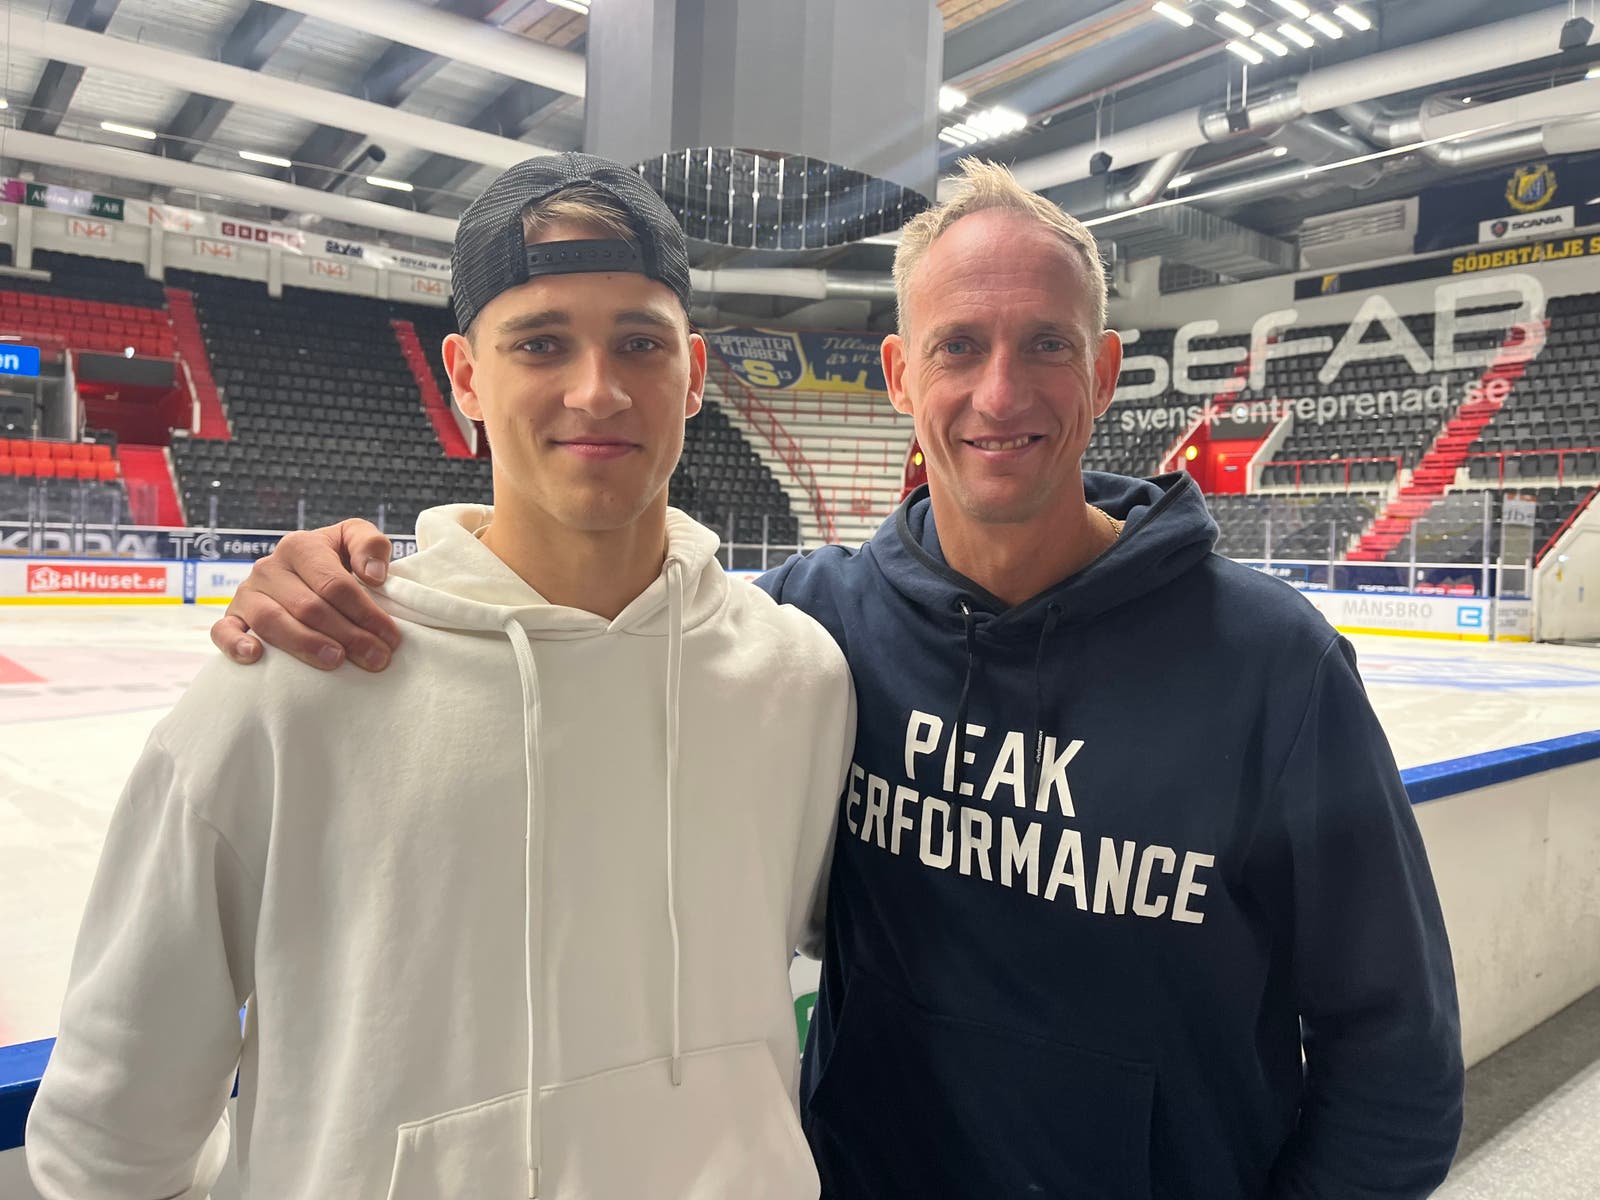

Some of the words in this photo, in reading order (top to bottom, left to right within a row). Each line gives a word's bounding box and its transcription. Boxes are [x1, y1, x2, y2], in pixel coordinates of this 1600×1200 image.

[1512, 215, 1562, 231] SCANIA
[1452, 239, 1584, 274] SÖDERTÄLJE
[708, 335, 793, 352] SUPPORTER
[720, 343, 788, 362] KLUBBEN
[742, 359, 781, 388] S
[1343, 598, 1432, 618] MÅNSBRO
[904, 709, 1085, 818] PEAK
